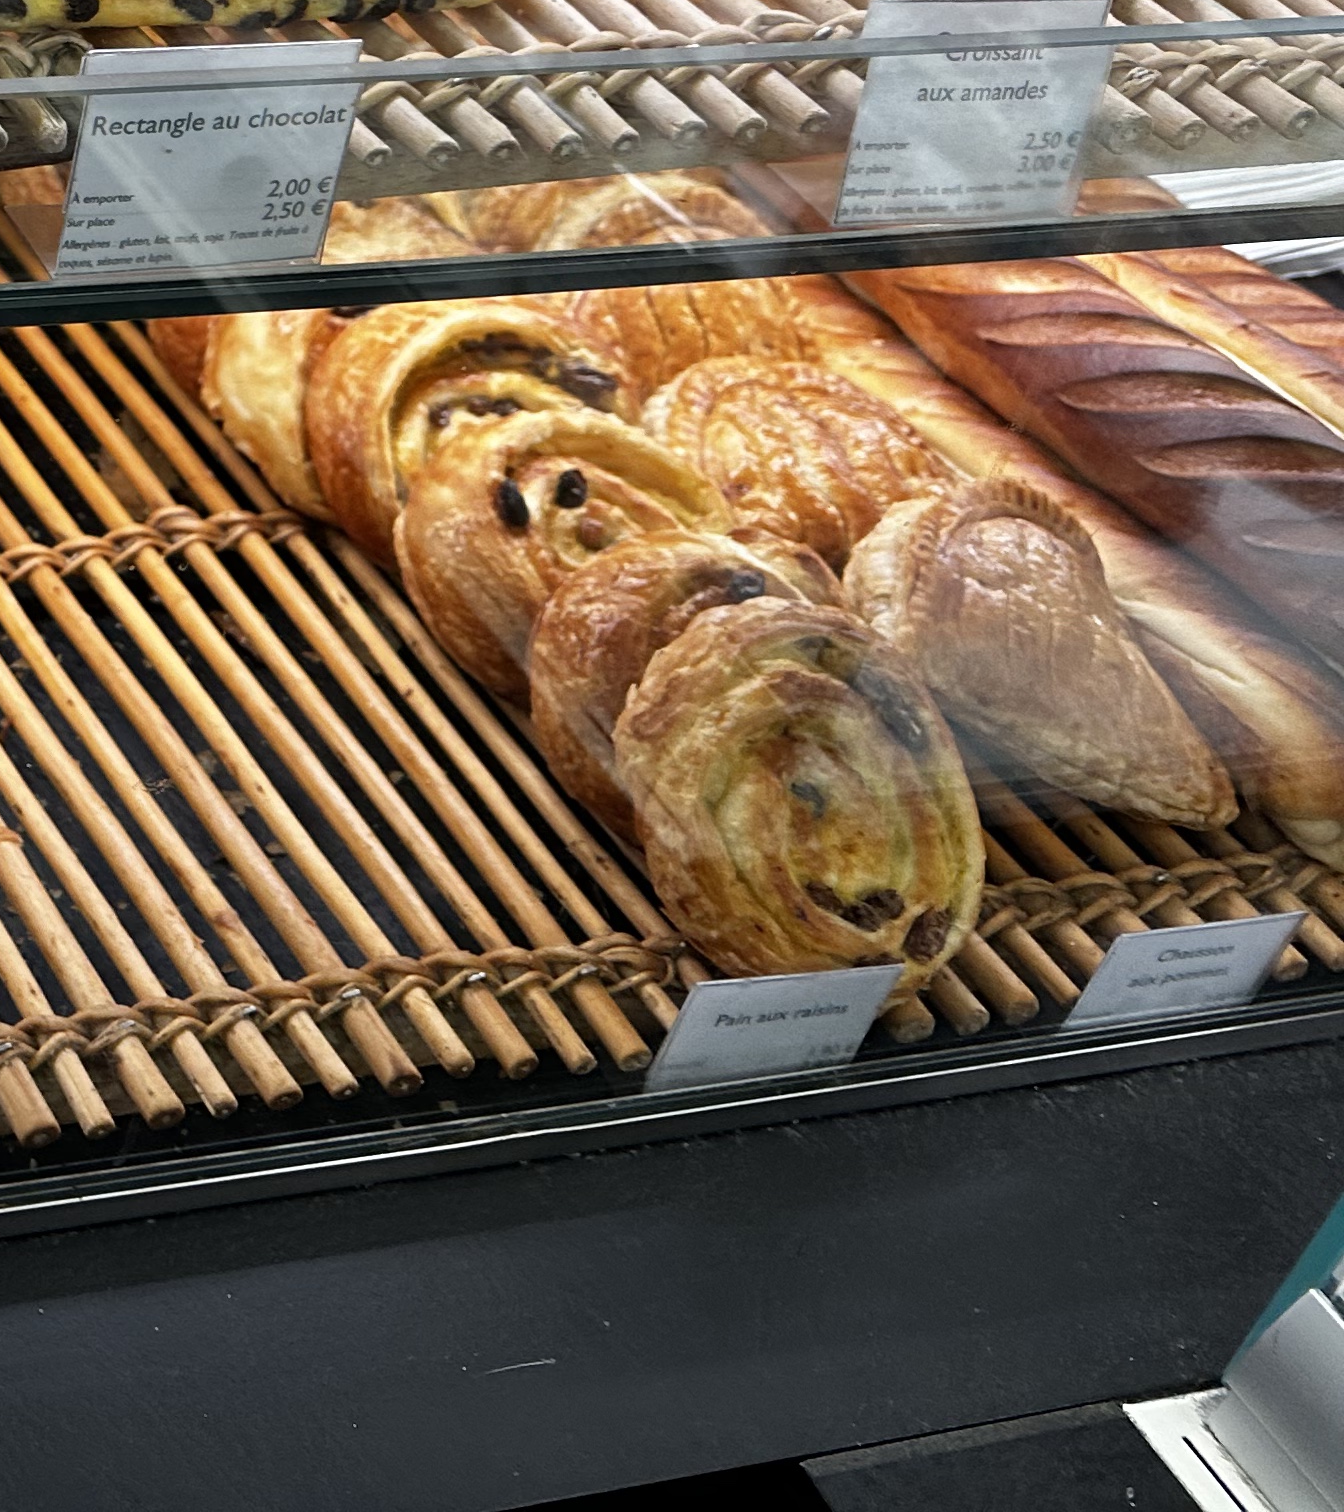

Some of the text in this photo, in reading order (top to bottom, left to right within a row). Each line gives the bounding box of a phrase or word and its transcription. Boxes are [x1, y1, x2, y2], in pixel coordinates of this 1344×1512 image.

[917, 80, 1049, 102] aux amandes
[91, 105, 347, 139] Rectangle au chocolat
[267, 176, 333, 199] 2,00 €
[82, 194, 135, 206] emporter
[261, 199, 328, 222] 2,50 €
[66, 217, 116, 229] Sur place
[715, 1002, 849, 1028] Pain aux raisins
